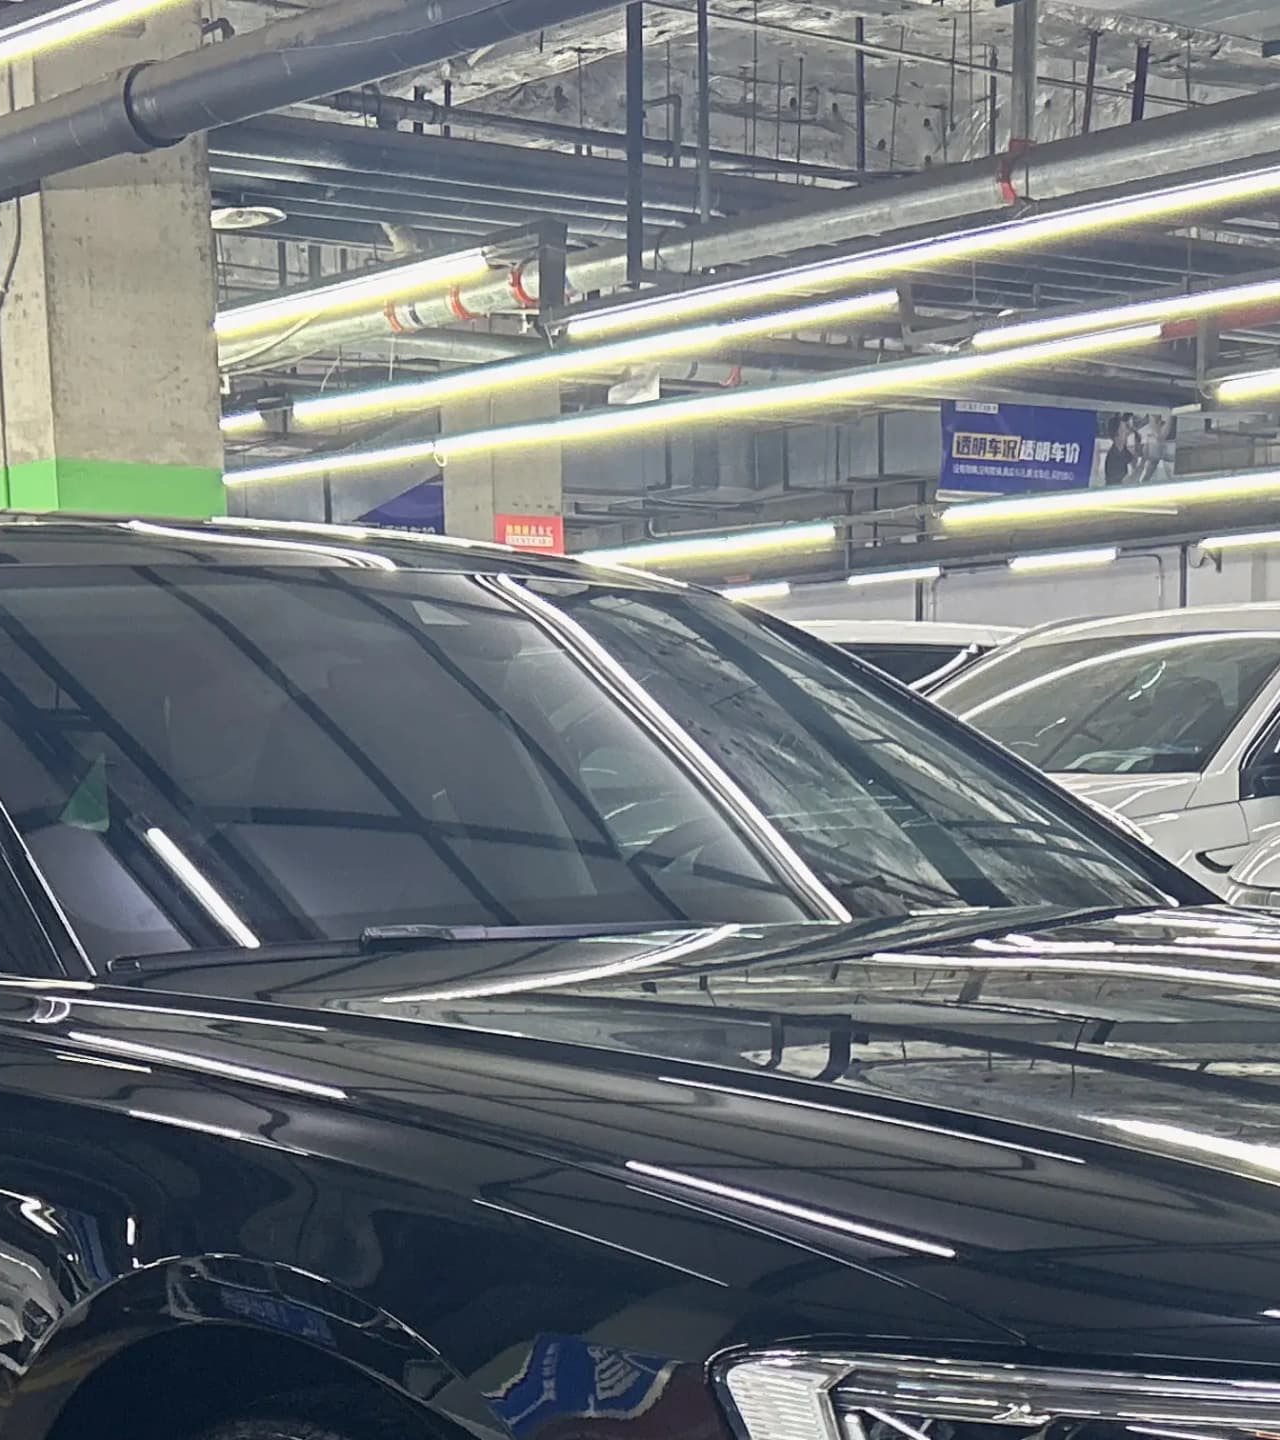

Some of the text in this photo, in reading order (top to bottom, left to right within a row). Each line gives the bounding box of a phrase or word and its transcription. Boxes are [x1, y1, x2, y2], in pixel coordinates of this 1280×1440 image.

[956, 435, 1081, 465] 透明车况 透明车价
